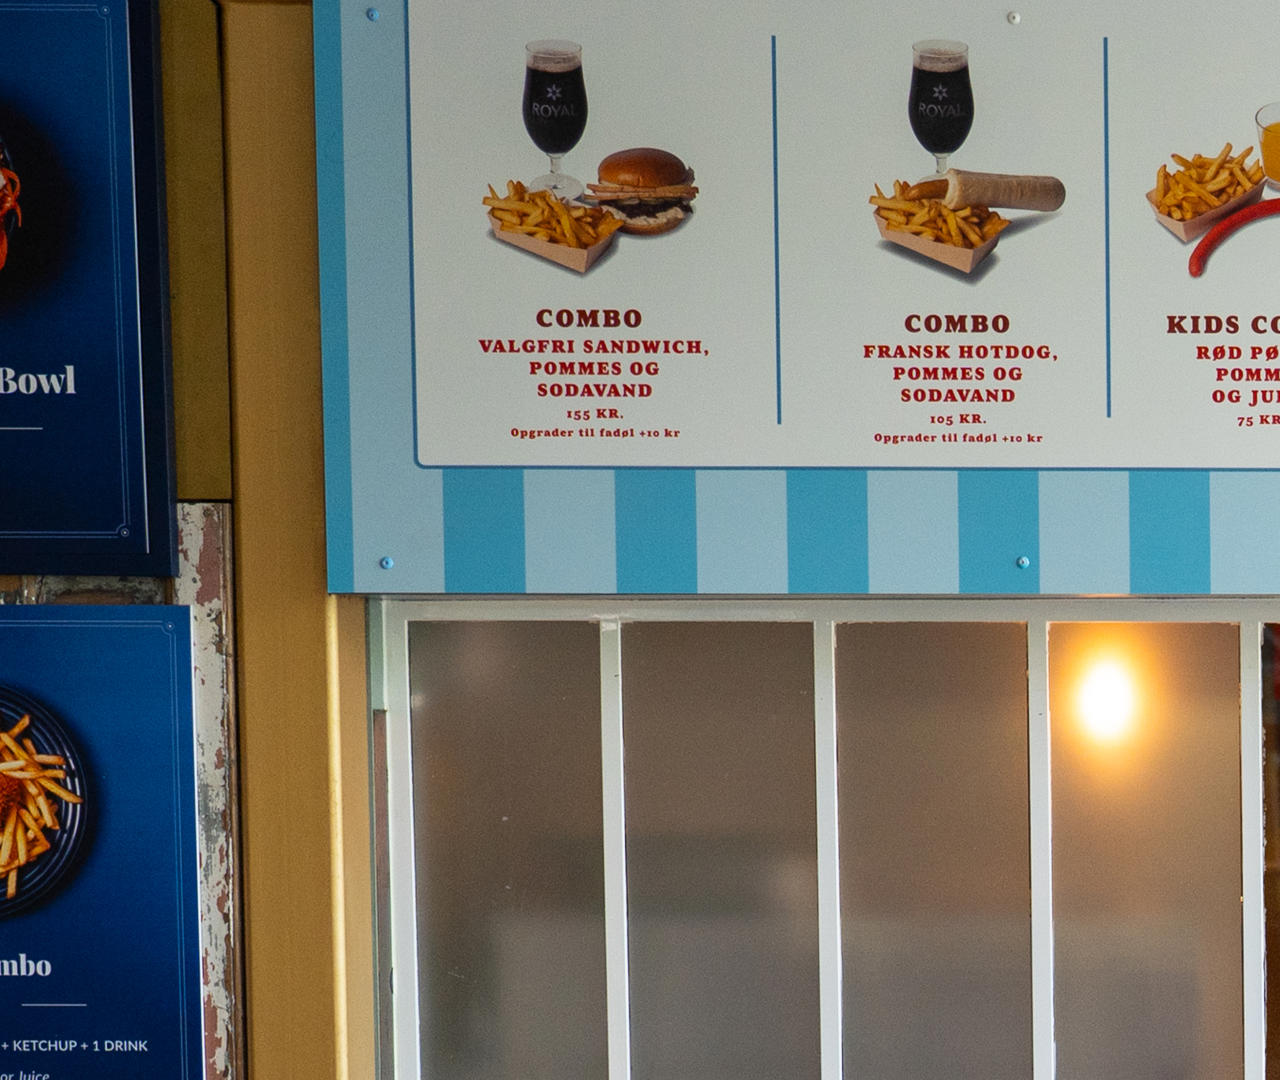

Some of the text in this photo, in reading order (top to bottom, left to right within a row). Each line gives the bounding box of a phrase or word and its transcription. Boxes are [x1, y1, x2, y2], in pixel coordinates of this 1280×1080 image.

[532, 102, 576, 118] ROYAL
[918, 102, 964, 118] ROYAL
[535, 308, 643, 329] COMBO
[903, 313, 1011, 334] COMBO
[1167, 313, 1241, 335] KIDS
[479, 338, 710, 356] VALGFRI SANDWICH,
[863, 343, 1058, 361] FRANSK HOTDOG,
[1196, 345, 1243, 361] RØD
[529, 360, 659, 377] POMMES OG
[893, 366, 1023, 382] POMMES OG
[0, 364, 77, 395] Bowl
[537, 382, 653, 398] SODAVAND
[900, 388, 1016, 403] SODAVAND
[1211, 389, 1241, 404] OG
[566, 407, 624, 421] 155 KR.
[929, 412, 988, 427] 105 KR.
[1237, 416, 1255, 427] 75
[509, 427, 681, 441] Opgrader til fadøl +10 kr
[873, 432, 1043, 446] Opgrader til fadøl +10 kr
[12, 1039, 78, 1052] KETCHUP
[92, 1040, 100, 1052] 1
[104, 1039, 148, 1052] DRINK
